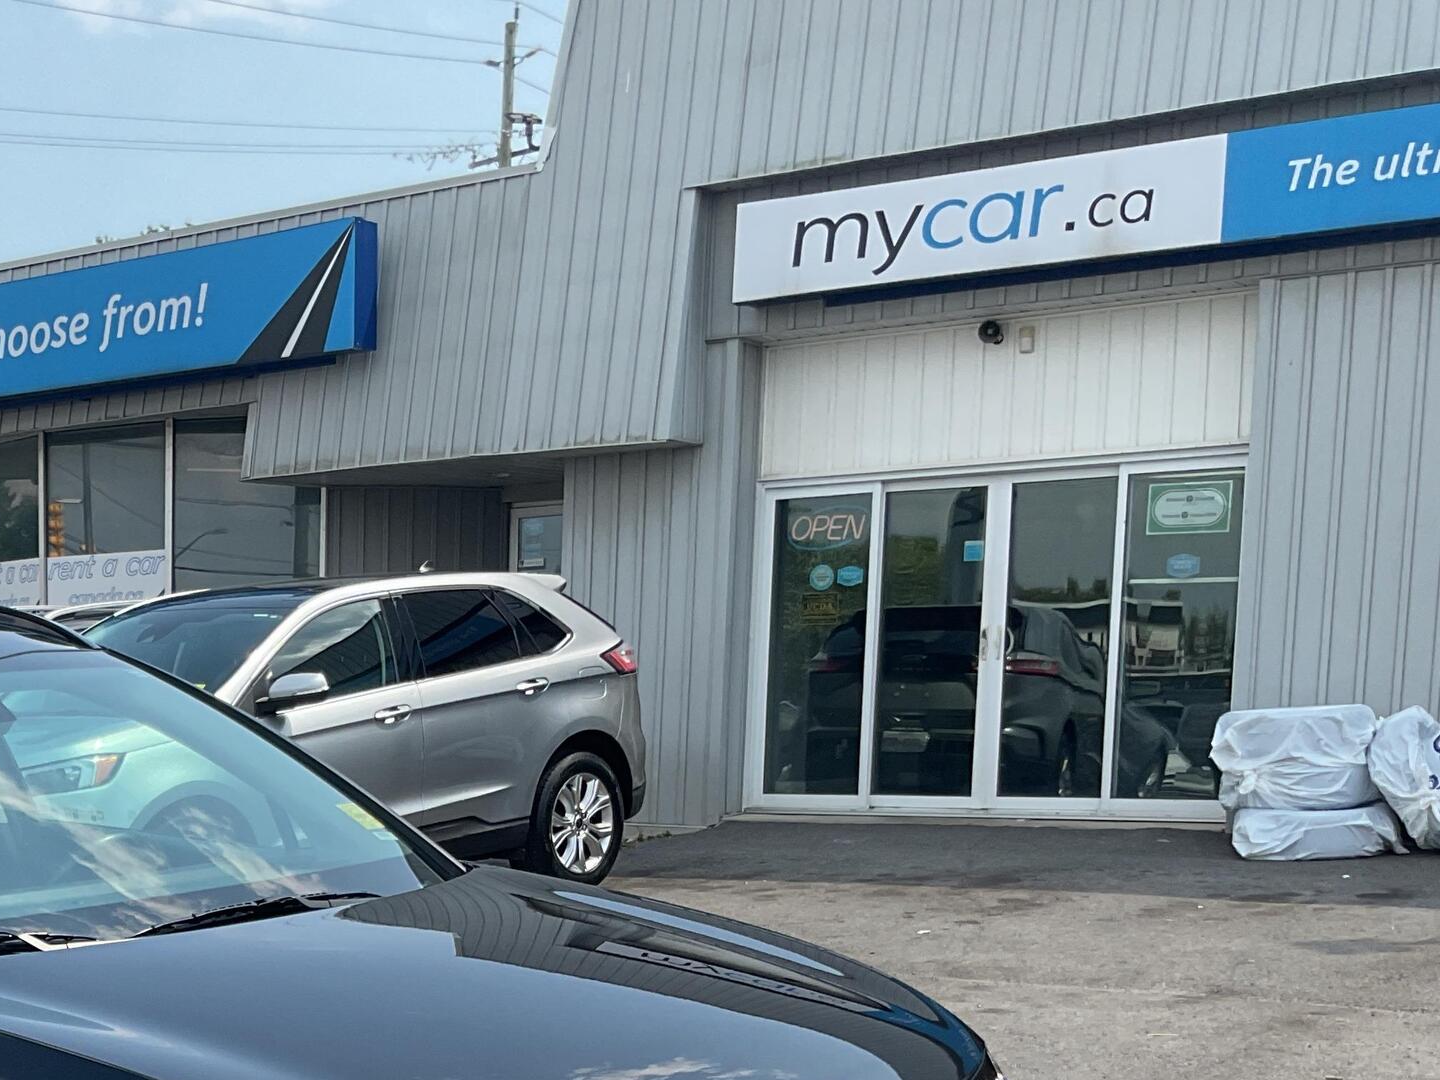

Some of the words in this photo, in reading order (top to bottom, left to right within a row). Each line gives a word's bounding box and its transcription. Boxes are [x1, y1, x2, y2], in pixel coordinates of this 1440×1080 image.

[1288, 154, 1360, 192] The
[792, 184, 1154, 276] mycar.ca
[98, 282, 209, 353] from!
[791, 514, 866, 541] OPEN
[47, 555, 96, 582] rent
[102, 558, 118, 578] a
[125, 554, 166, 577] car
